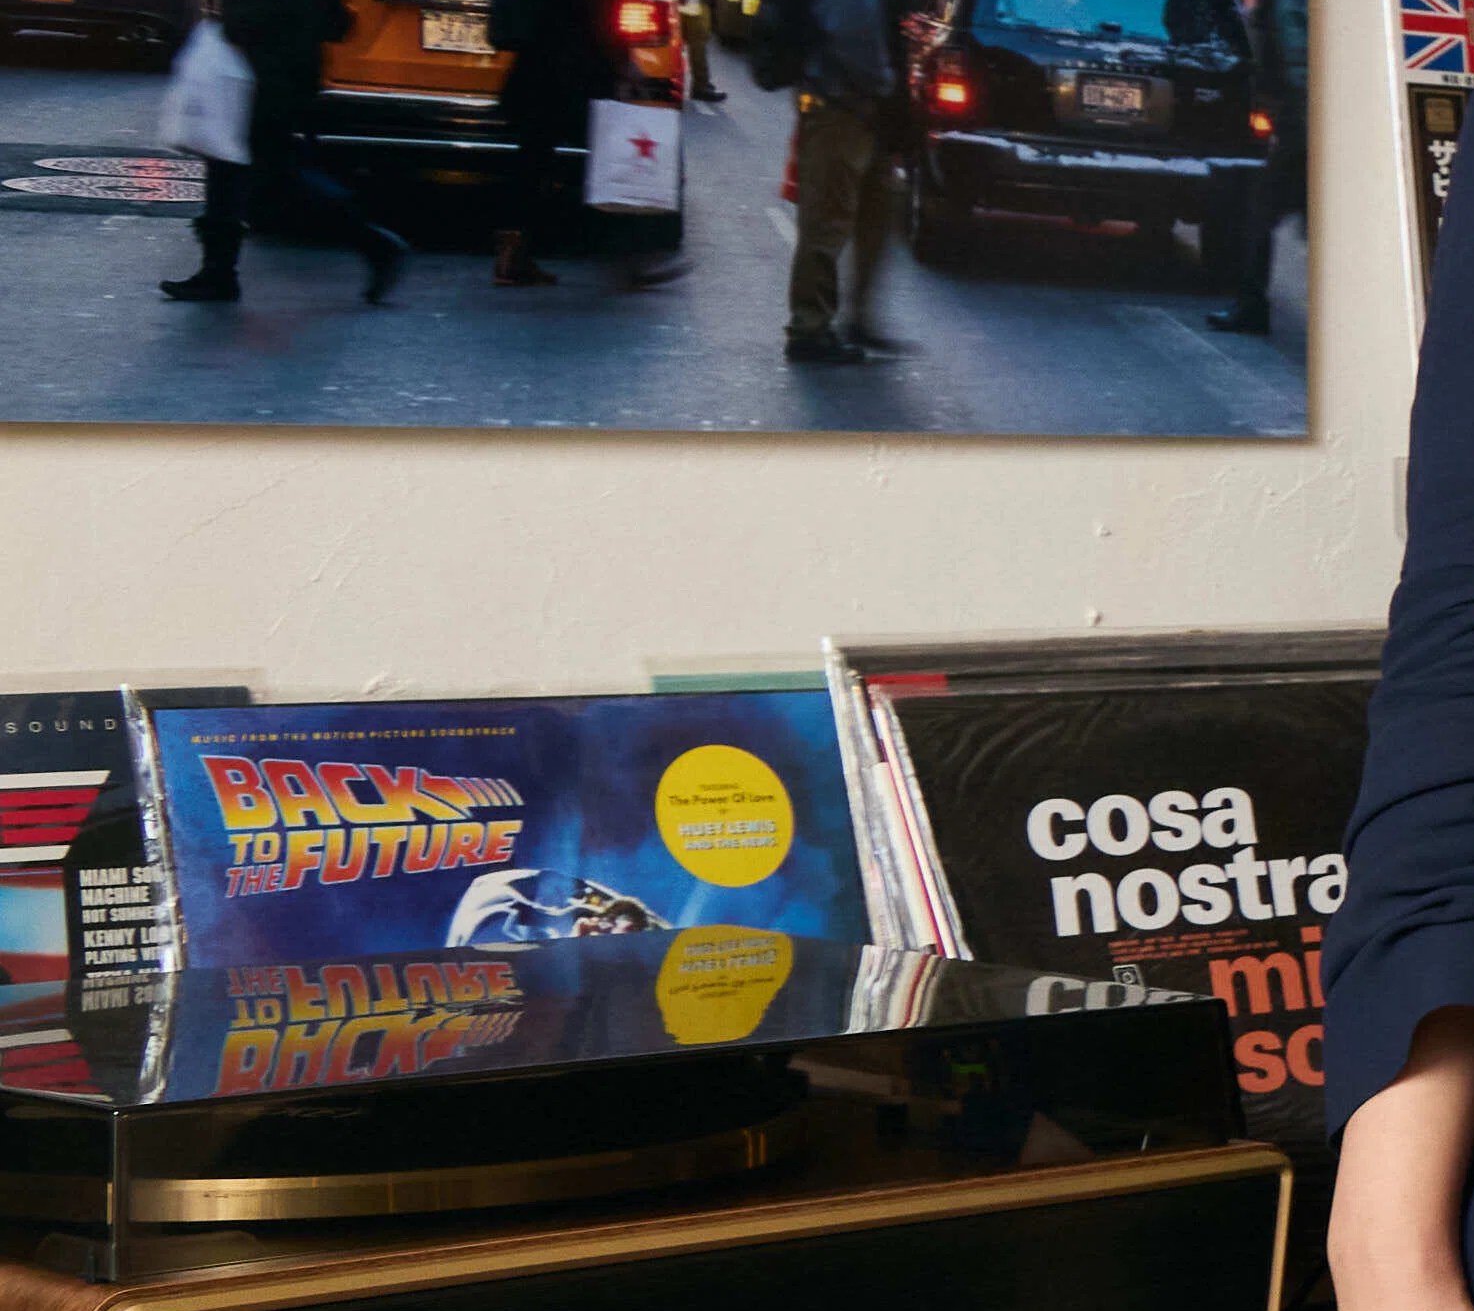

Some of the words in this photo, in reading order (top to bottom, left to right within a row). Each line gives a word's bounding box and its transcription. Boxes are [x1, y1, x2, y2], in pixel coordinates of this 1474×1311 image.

[5, 718, 118, 734] SOUND
[191, 733, 236, 745] MUSIC
[241, 732, 279, 743] FROM
[283, 731, 308, 742] THE
[312, 730, 366, 741] MOTION
[368, 729, 426, 739] PICTURE
[429, 726, 517, 738] SOUNDTRACK
[199, 754, 480, 831] BACK
[1026, 786, 1258, 862] cosa
[226, 832, 282, 866] TO
[282, 820, 524, 892] FUTURE
[80, 867, 128, 887] MIAMI
[226, 866, 283, 899] THE
[1050, 844, 1349, 937] nostra
[83, 927, 137, 948] KENNY
